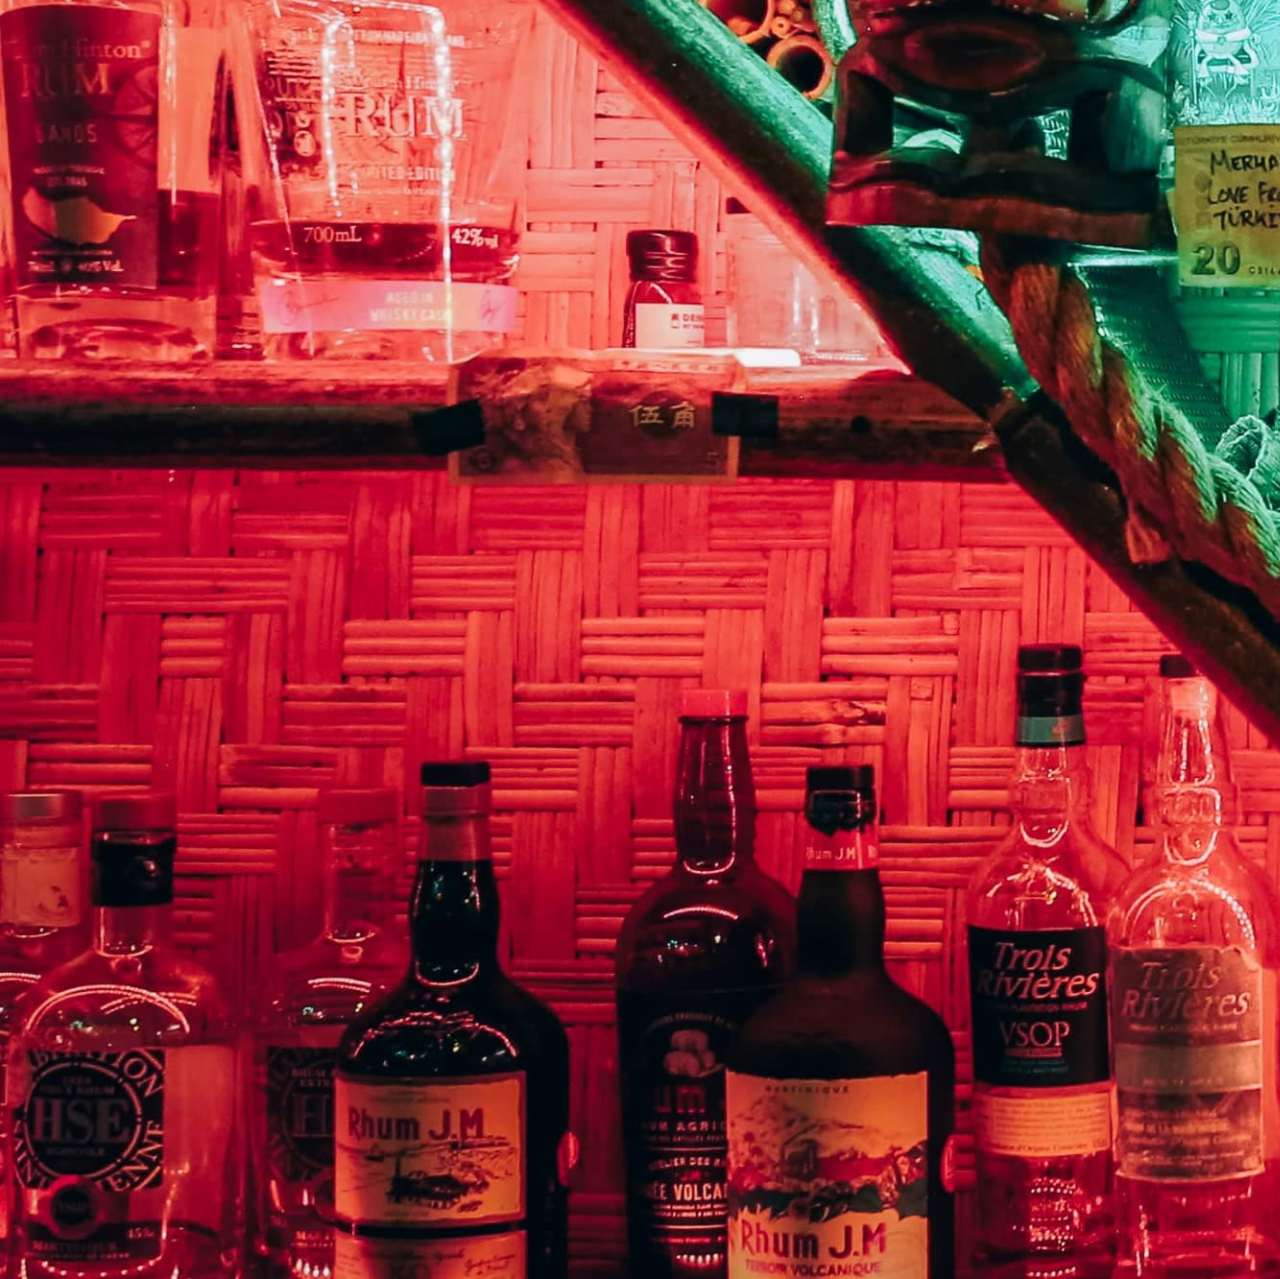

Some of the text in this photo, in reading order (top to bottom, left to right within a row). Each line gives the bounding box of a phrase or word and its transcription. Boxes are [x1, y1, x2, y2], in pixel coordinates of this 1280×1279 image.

[348, 94, 468, 141] RUM
[1190, 241, 1242, 276] 20
[629, 402, 697, 429] 伍角
[992, 941, 1072, 971] Trois
[976, 970, 1100, 1001] Rivières
[1000, 1020, 1071, 1048] VSOP
[31, 1097, 131, 1144] HSE
[347, 1106, 485, 1141] Rhum J.M
[740, 1219, 889, 1260] Rhum J.M
